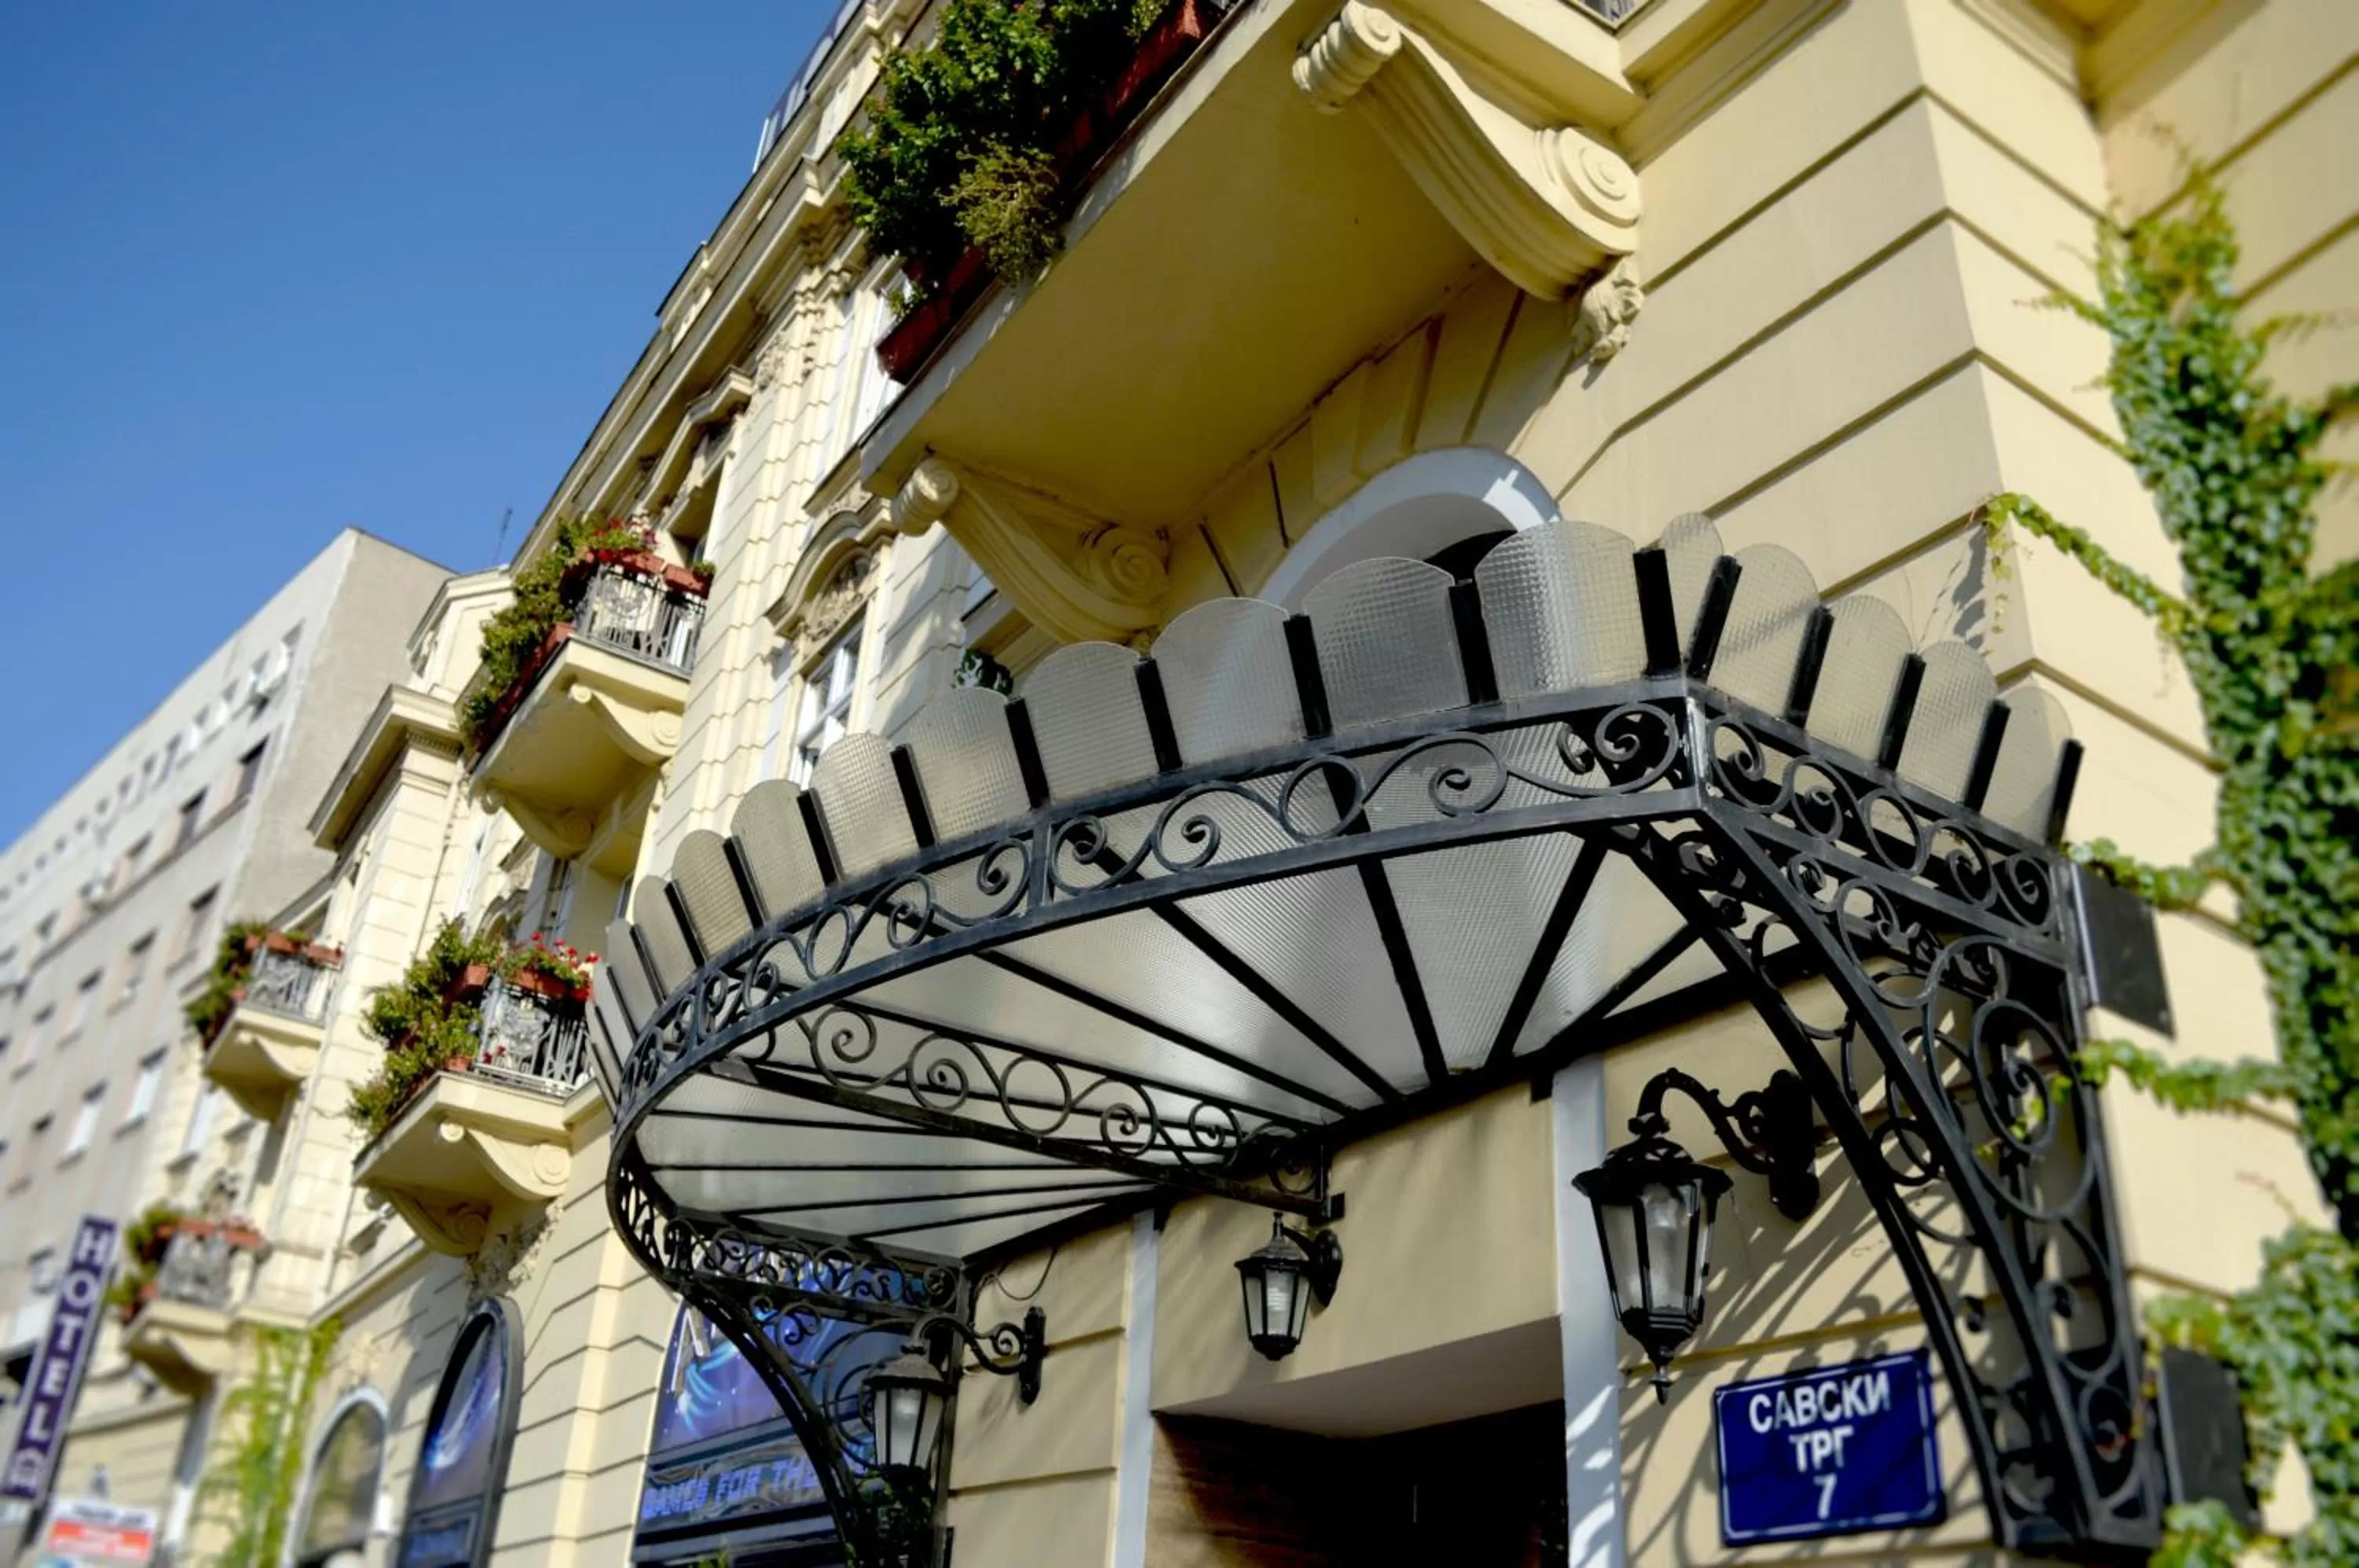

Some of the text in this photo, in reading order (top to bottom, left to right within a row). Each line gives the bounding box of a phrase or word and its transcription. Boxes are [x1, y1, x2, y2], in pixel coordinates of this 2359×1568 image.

[25, 1227, 110, 1442] HOTEL
[1748, 1371, 1891, 1434] САВСКИ
[1787, 1424, 1855, 1473] ТРГ
[715, 1465, 762, 1504] FOR
[1812, 1472, 1838, 1520] 7
